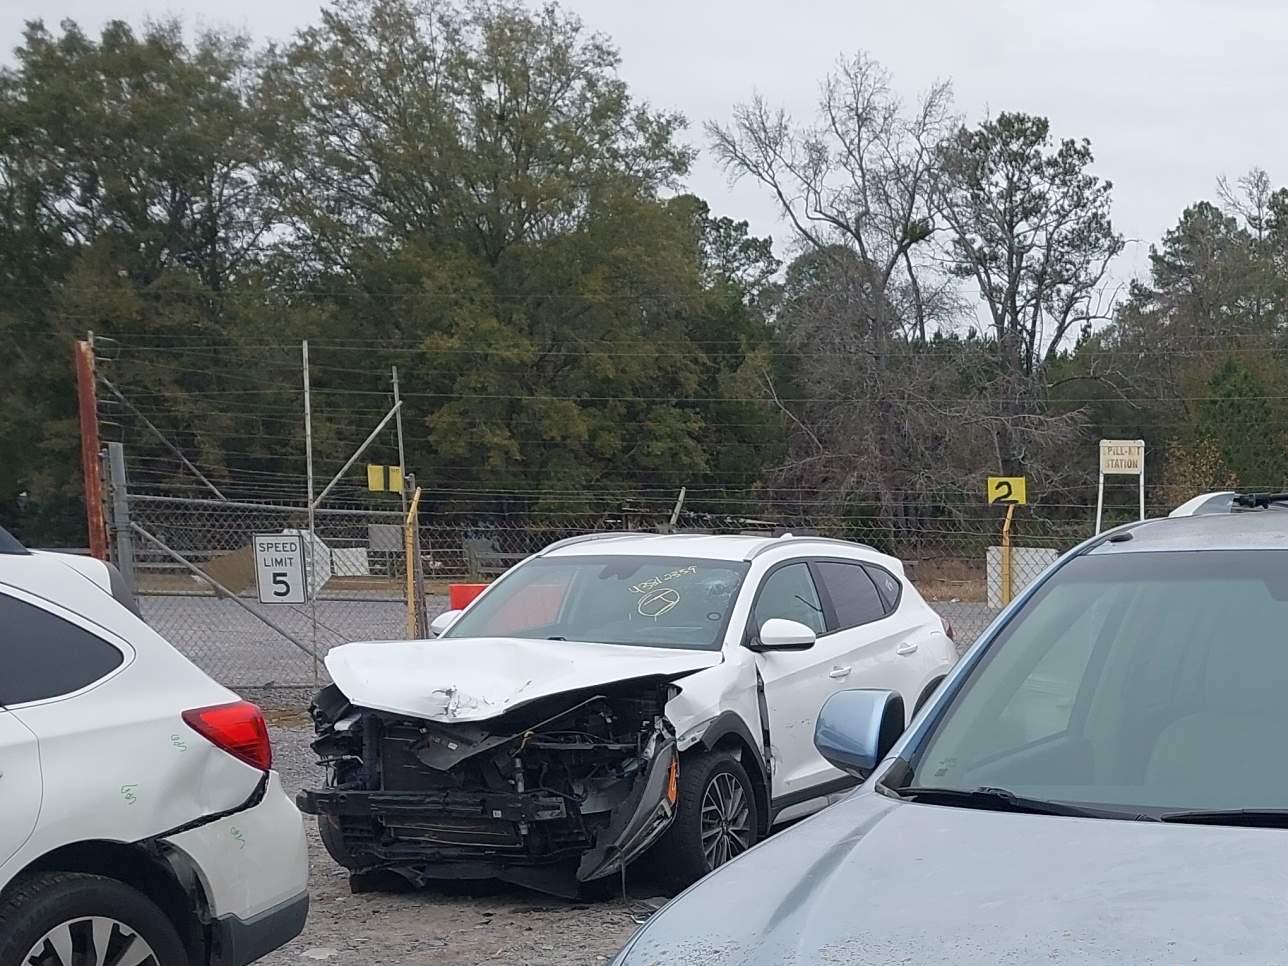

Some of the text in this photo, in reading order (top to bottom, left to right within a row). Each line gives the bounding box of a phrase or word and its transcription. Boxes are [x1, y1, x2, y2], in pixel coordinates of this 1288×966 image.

[991, 481, 1019, 504] 2
[258, 542, 298, 553] SPEED
[263, 557, 294, 568] LIMIT
[271, 572, 291, 597] 5
